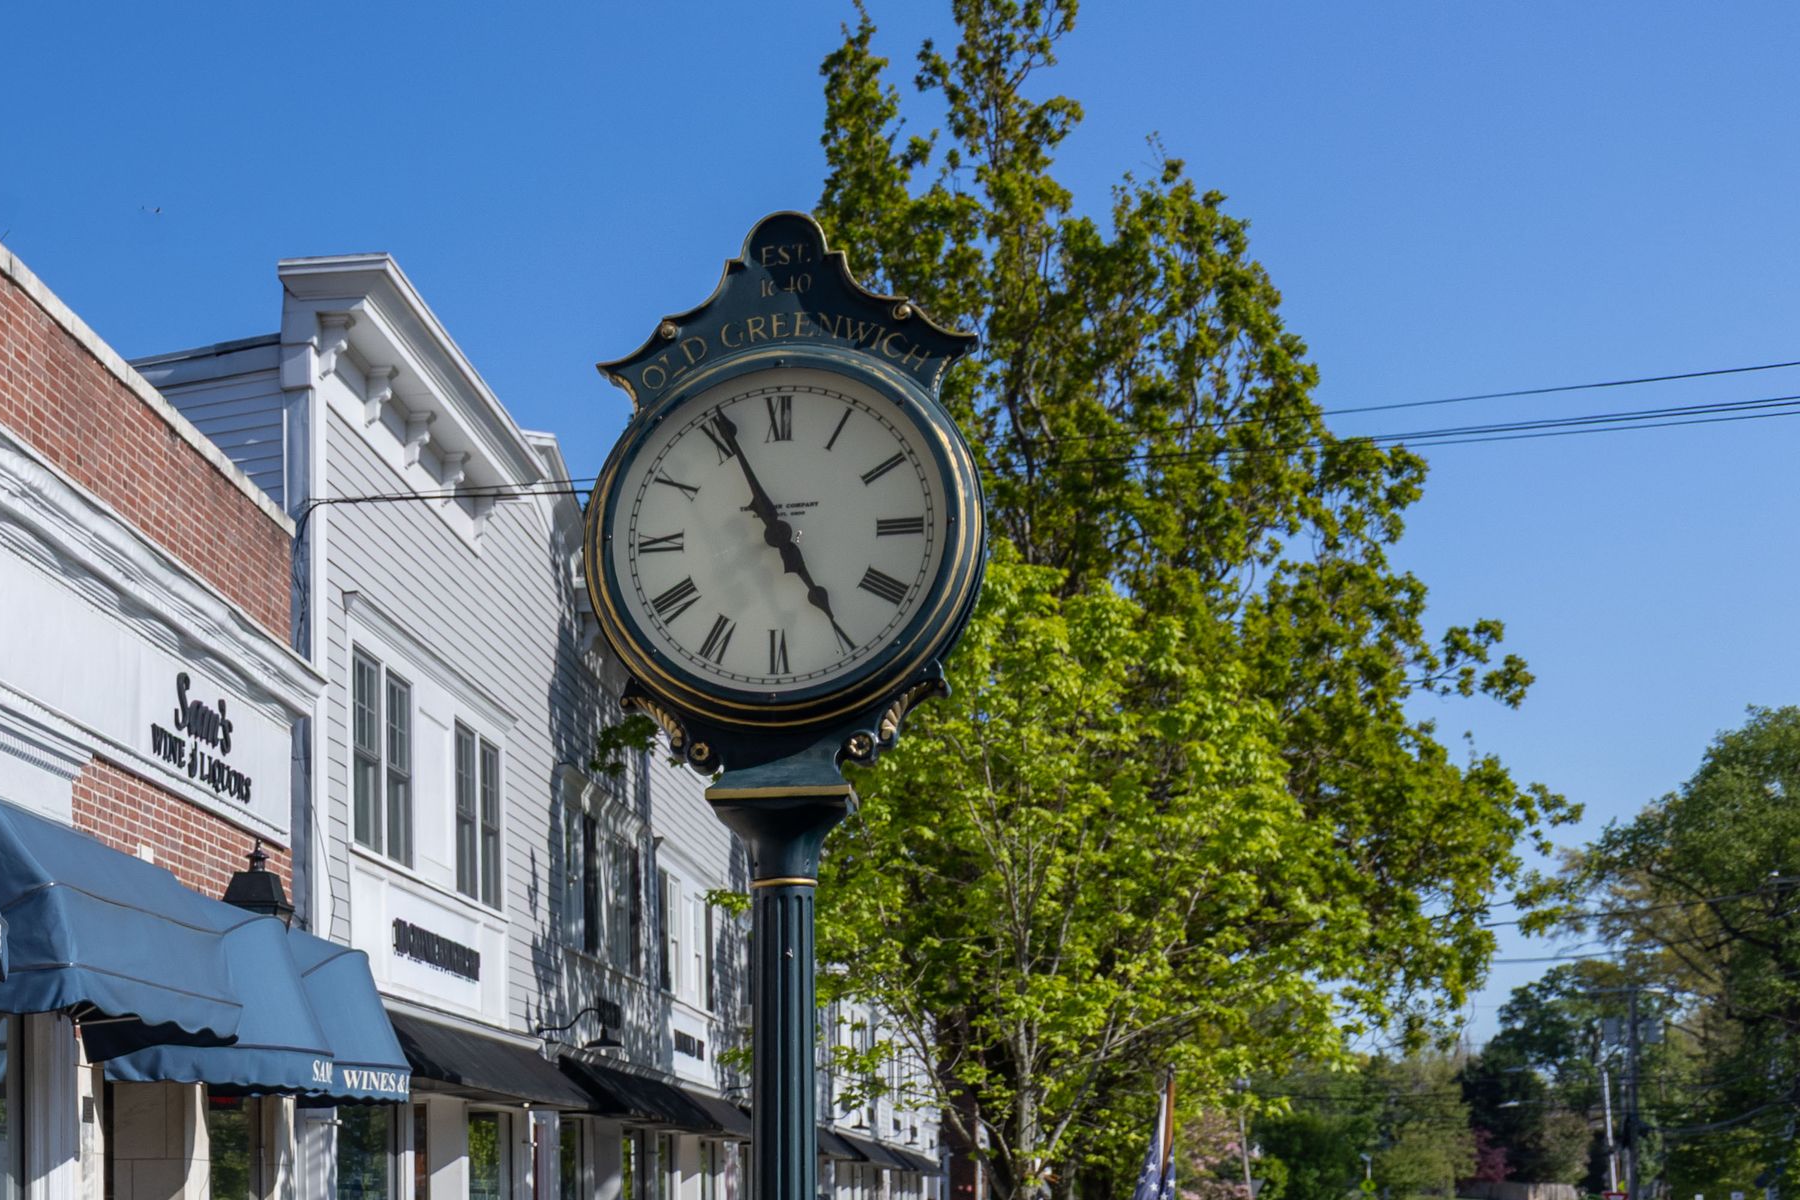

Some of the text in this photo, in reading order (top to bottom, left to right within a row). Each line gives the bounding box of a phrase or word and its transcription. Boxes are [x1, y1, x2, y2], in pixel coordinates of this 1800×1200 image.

[761, 244, 811, 267] EST.
[641, 311, 931, 390] OLD GREENWICH
[174, 672, 233, 757] Sam's
[151, 723, 186, 769] WINE
[200, 752, 252, 804] LIQUORS
[343, 1069, 396, 1092] WINES
